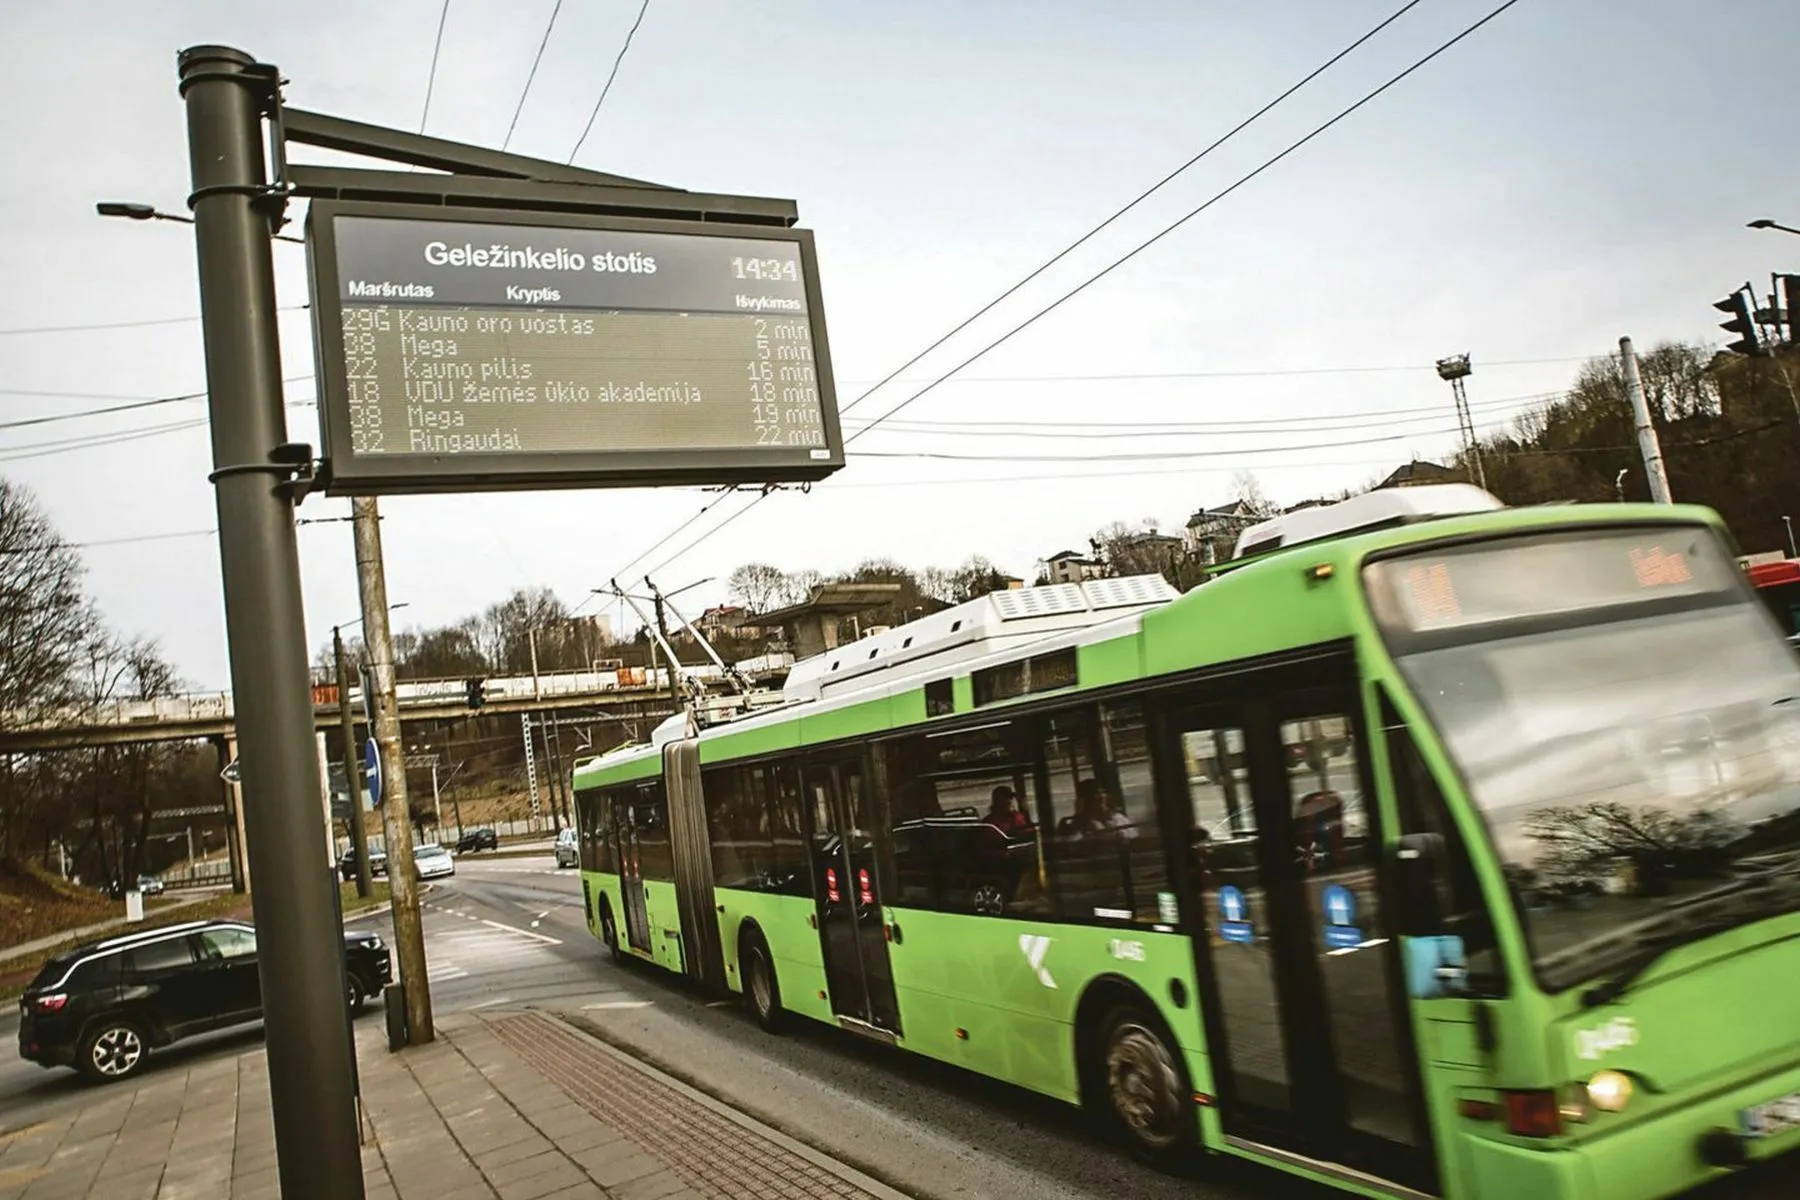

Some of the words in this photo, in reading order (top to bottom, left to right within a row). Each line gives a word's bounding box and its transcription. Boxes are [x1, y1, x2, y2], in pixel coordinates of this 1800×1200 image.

[425, 241, 585, 271] Geležinkelio
[592, 251, 657, 274] stotis
[732, 256, 798, 281] 14:34
[348, 280, 434, 298] Maršrutas
[506, 285, 561, 303] Kryptis
[735, 294, 801, 312] Išvykimas
[341, 307, 390, 331] 29G
[399, 309, 469, 332] Kauno
[476, 317, 513, 334] oro
[519, 313, 595, 335] uostas
[754, 319, 768, 339] 2
[774, 320, 809, 340] min
[343, 332, 376, 355] 38
[400, 333, 458, 358] Mega
[757, 340, 770, 360] 5
[778, 340, 811, 360] min
[344, 356, 378, 379] 22
[402, 356, 472, 379] Kauno
[481, 357, 533, 382] pilis
[747, 361, 773, 381] 16
[781, 361, 815, 381] min
[347, 380, 380, 403] 18
[405, 381, 454, 403] VDU
[599, 381, 701, 405] akademija
[750, 382, 776, 402] 18
[783, 382, 817, 402] min
[349, 405, 382, 428] 38
[407, 405, 464, 430] Mega
[753, 403, 779, 423] 19
[786, 403, 820, 424] min
[351, 429, 385, 452] 32
[409, 428, 522, 453] Ringaudai
[755, 425, 782, 445] 22
[788, 424, 823, 445] min
